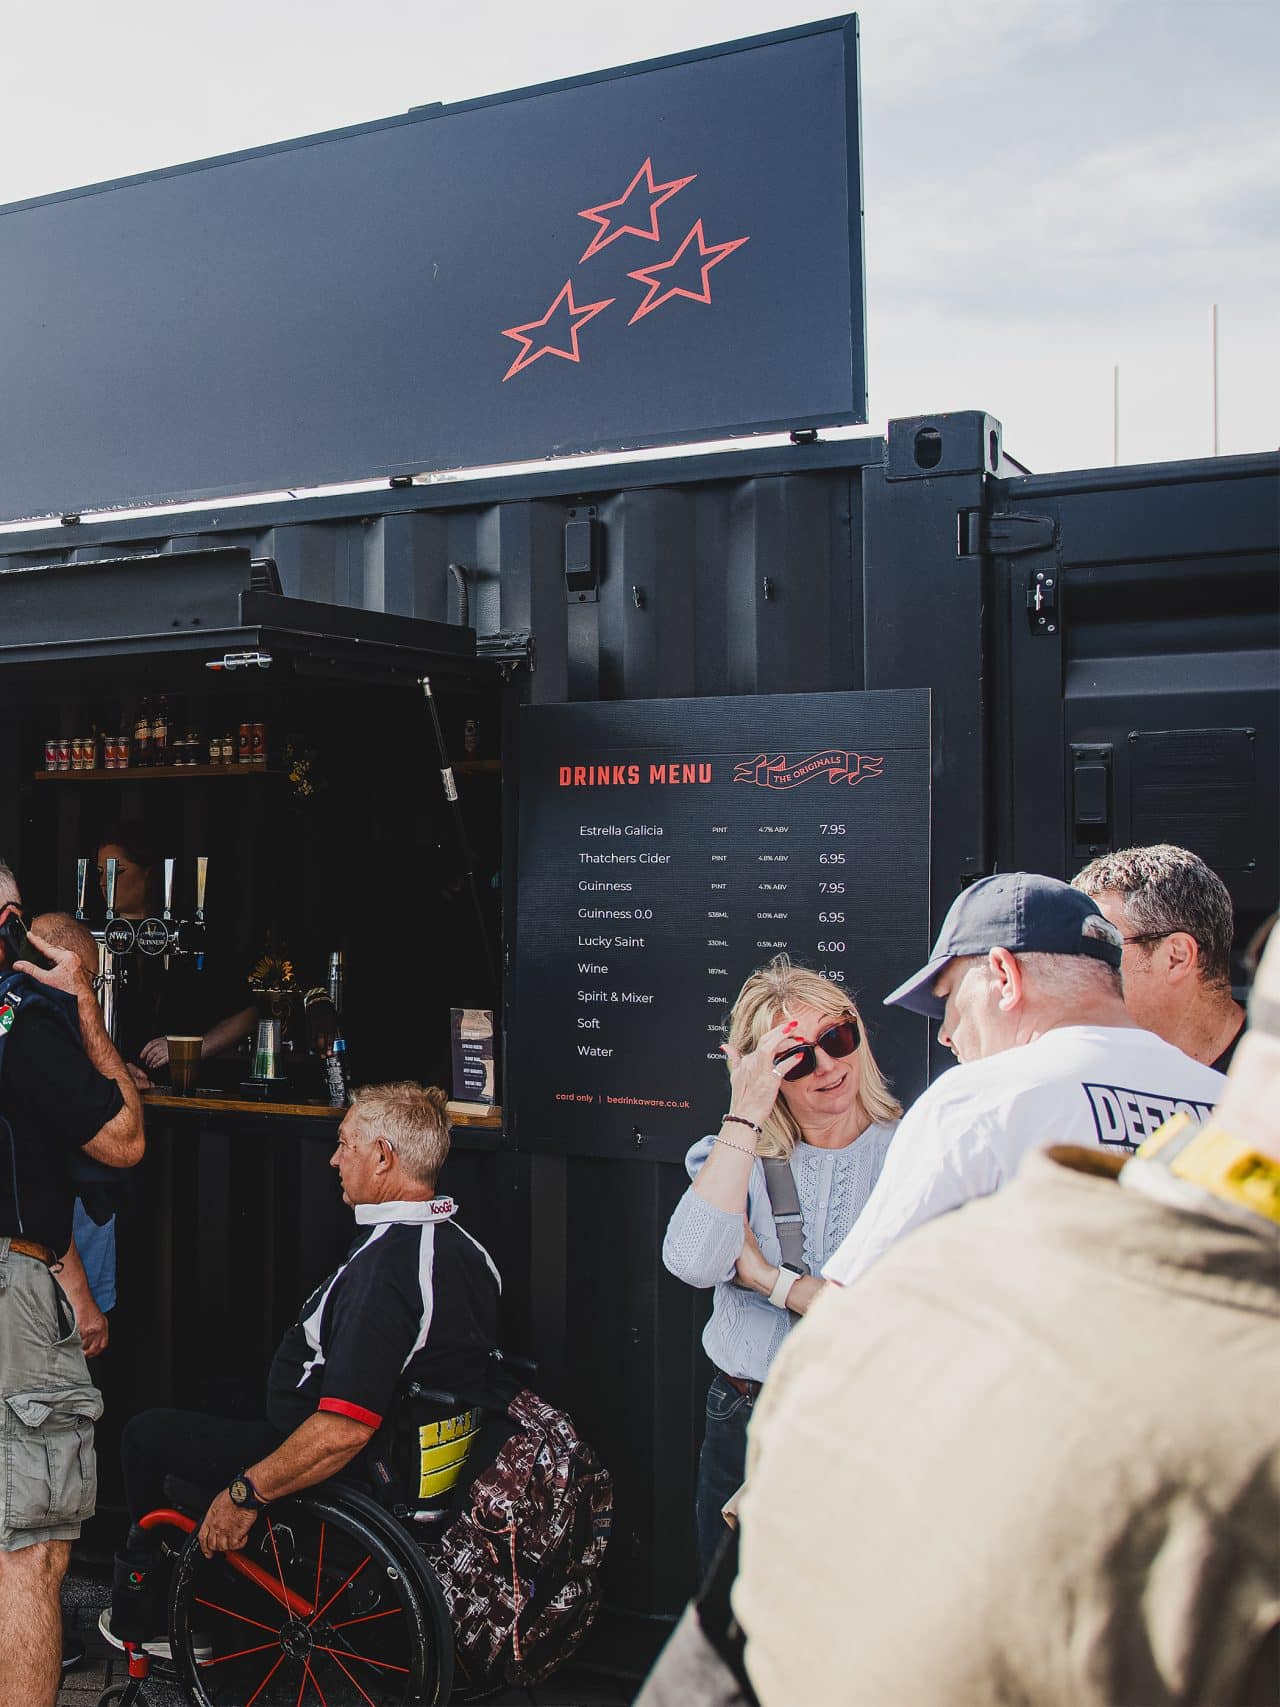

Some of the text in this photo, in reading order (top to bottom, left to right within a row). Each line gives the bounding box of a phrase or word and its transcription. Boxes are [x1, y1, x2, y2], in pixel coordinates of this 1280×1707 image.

[559, 763, 712, 786] DRINKS MENU
[774, 756, 841, 783] THE ORIGINALS
[579, 825, 622, 836] Estrella
[624, 824, 664, 836] Galicia
[819, 824, 846, 835] 7.95
[578, 852, 637, 864] Thatchers
[638, 852, 671, 864] Cider
[819, 853, 846, 864] 6.95
[578, 880, 633, 891] Guinness
[818, 882, 845, 894] 7.95
[578, 908, 632, 919] Guinness
[634, 908, 653, 920] 0.0
[818, 911, 845, 923] 6.95
[578, 935, 612, 949] Lucky
[614, 936, 645, 948] Saint
[707, 939, 729, 947] 330ML
[817, 941, 846, 953] 6.00
[577, 963, 609, 974] Wine
[818, 970, 845, 983] 6.95
[577, 990, 729, 1004] Spirit & Mixer 250ML
[577, 1017, 729, 1033] Soft 330ML
[577, 1045, 614, 1057] Water
[555, 1093, 690, 1109] card only bedrinkaware.co.uk
